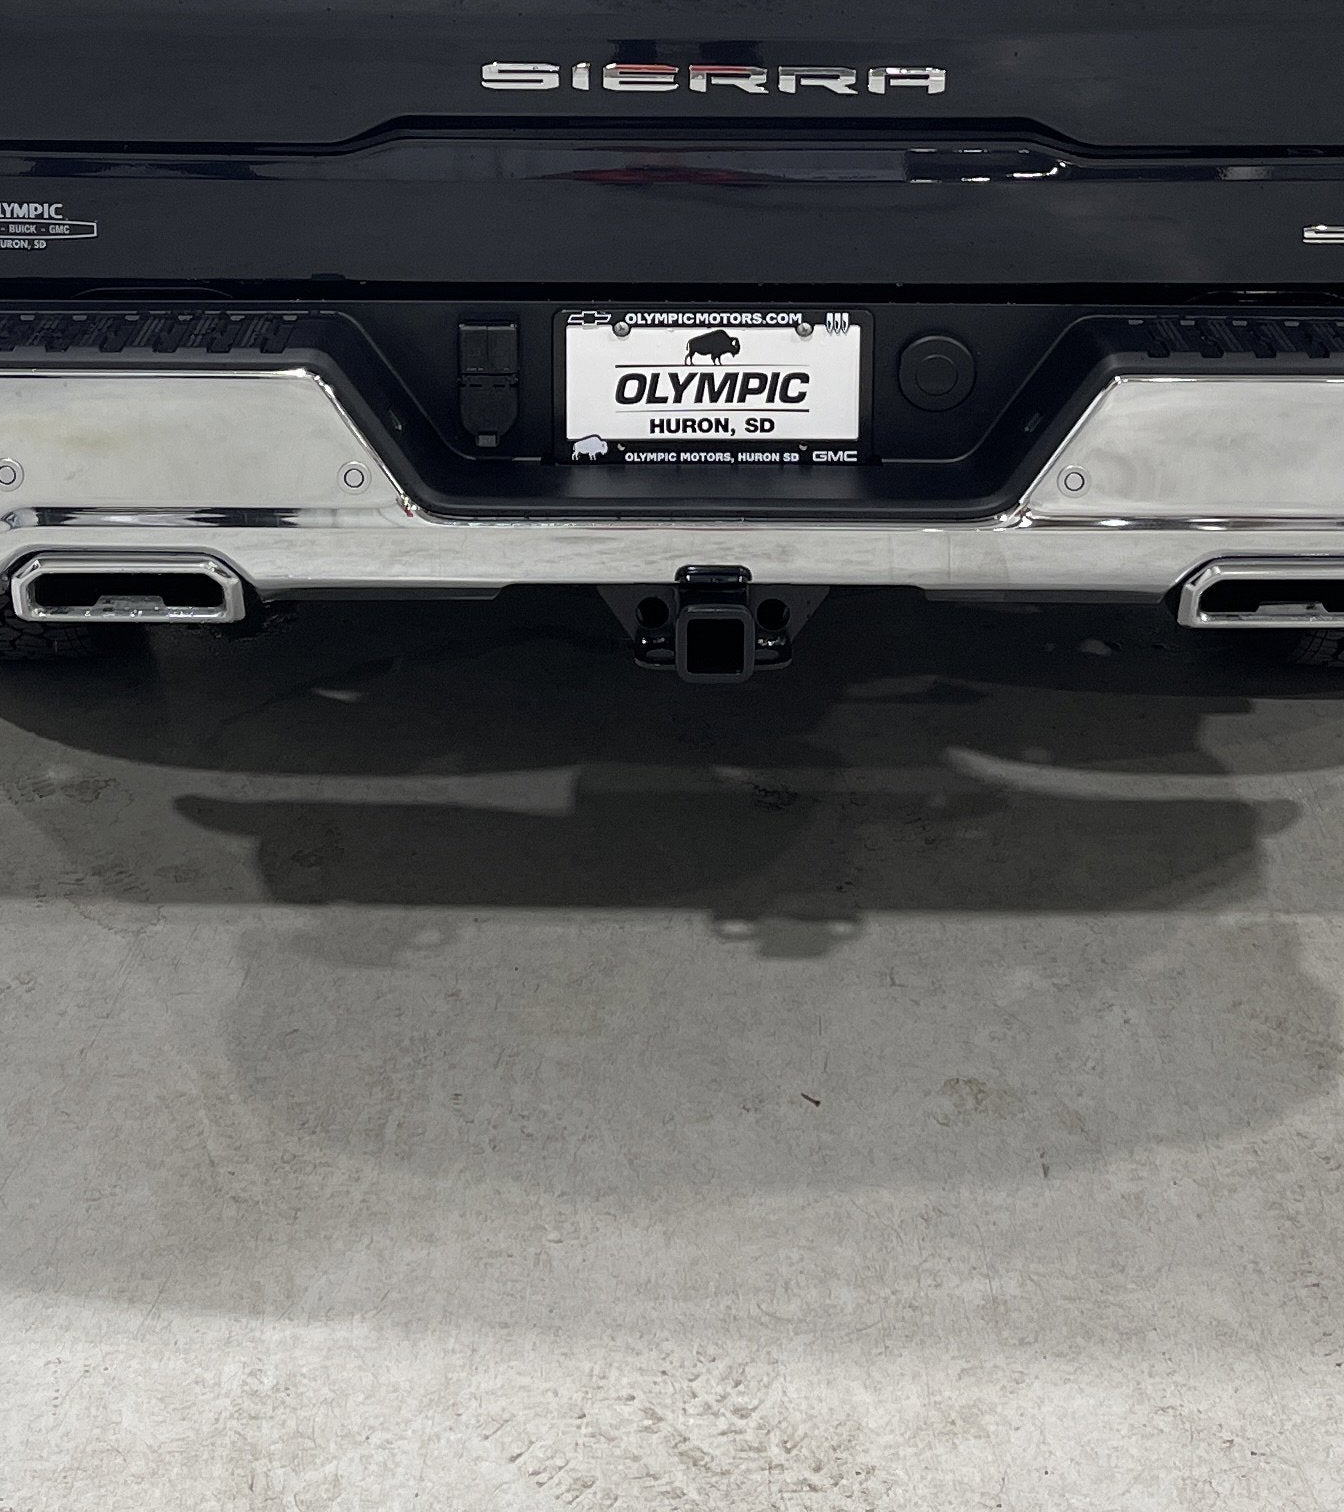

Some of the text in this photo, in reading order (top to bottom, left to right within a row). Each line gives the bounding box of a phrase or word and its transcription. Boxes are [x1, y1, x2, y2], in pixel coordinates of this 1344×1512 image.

[480, 61, 947, 96] SIERRA
[8, 223, 37, 234] BUICK
[49, 224, 71, 234] GMC
[33, 239, 47, 249] SD
[624, 311, 803, 326] OLYMPICMOTORS.COM
[614, 371, 810, 405] OLYMPIC
[649, 417, 776, 437] HURON, SD
[624, 451, 800, 464] OLYMPIC MOTORS, HURON SD
[812, 450, 858, 462] GMC
